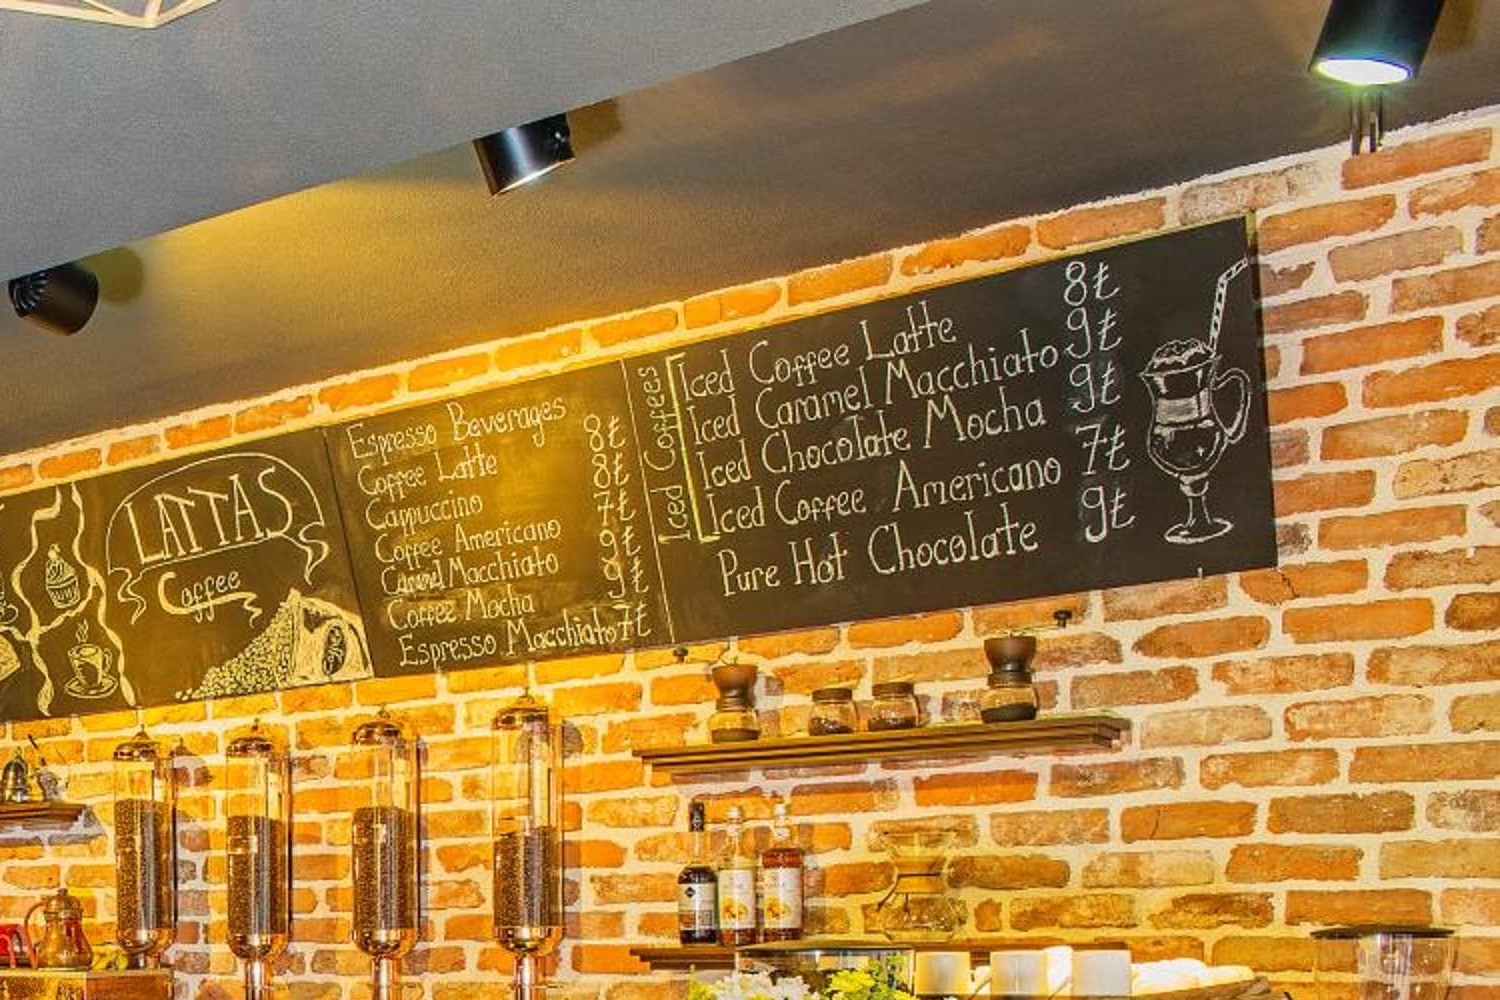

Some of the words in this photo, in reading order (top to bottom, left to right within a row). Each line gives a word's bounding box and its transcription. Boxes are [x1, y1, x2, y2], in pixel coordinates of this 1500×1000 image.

[677, 349, 736, 401] Iced
[749, 340, 851, 387] Coffee
[859, 300, 957, 361] Latte
[687, 395, 742, 446] Iced
[755, 365, 874, 430] Caramel
[885, 327, 1059, 405] Macchiato
[346, 424, 438, 460] Espresso
[446, 397, 568, 447] Beverages
[638, 365, 678, 472] Coffees
[697, 439, 752, 490] Iced
[761, 409, 912, 474] Chocolate
[923, 385, 1048, 449] Mocha
[357, 464, 427, 503] Coffee
[436, 445, 498, 482] Latte
[706, 486, 766, 535] Iced
[775, 479, 867, 526] Coffee
[892, 457, 1061, 512] Americano
[125, 465, 293, 565] LATTAS
[365, 491, 484, 537] Cappuccino
[651, 484, 691, 544] Iced
[375, 533, 443, 571] Coffee
[453, 519, 562, 553] Americano
[448, 545, 560, 588] Macchiato
[717, 549, 781, 598] Pure
[788, 531, 849, 586] Hot
[867, 502, 1040, 575] Chocolate
[158, 571, 252, 624] Coffee
[388, 598, 457, 631] Coffee
[465, 584, 535, 621] Mocha
[398, 633, 497, 669] Espresso
[506, 609, 617, 656] Macchiato
